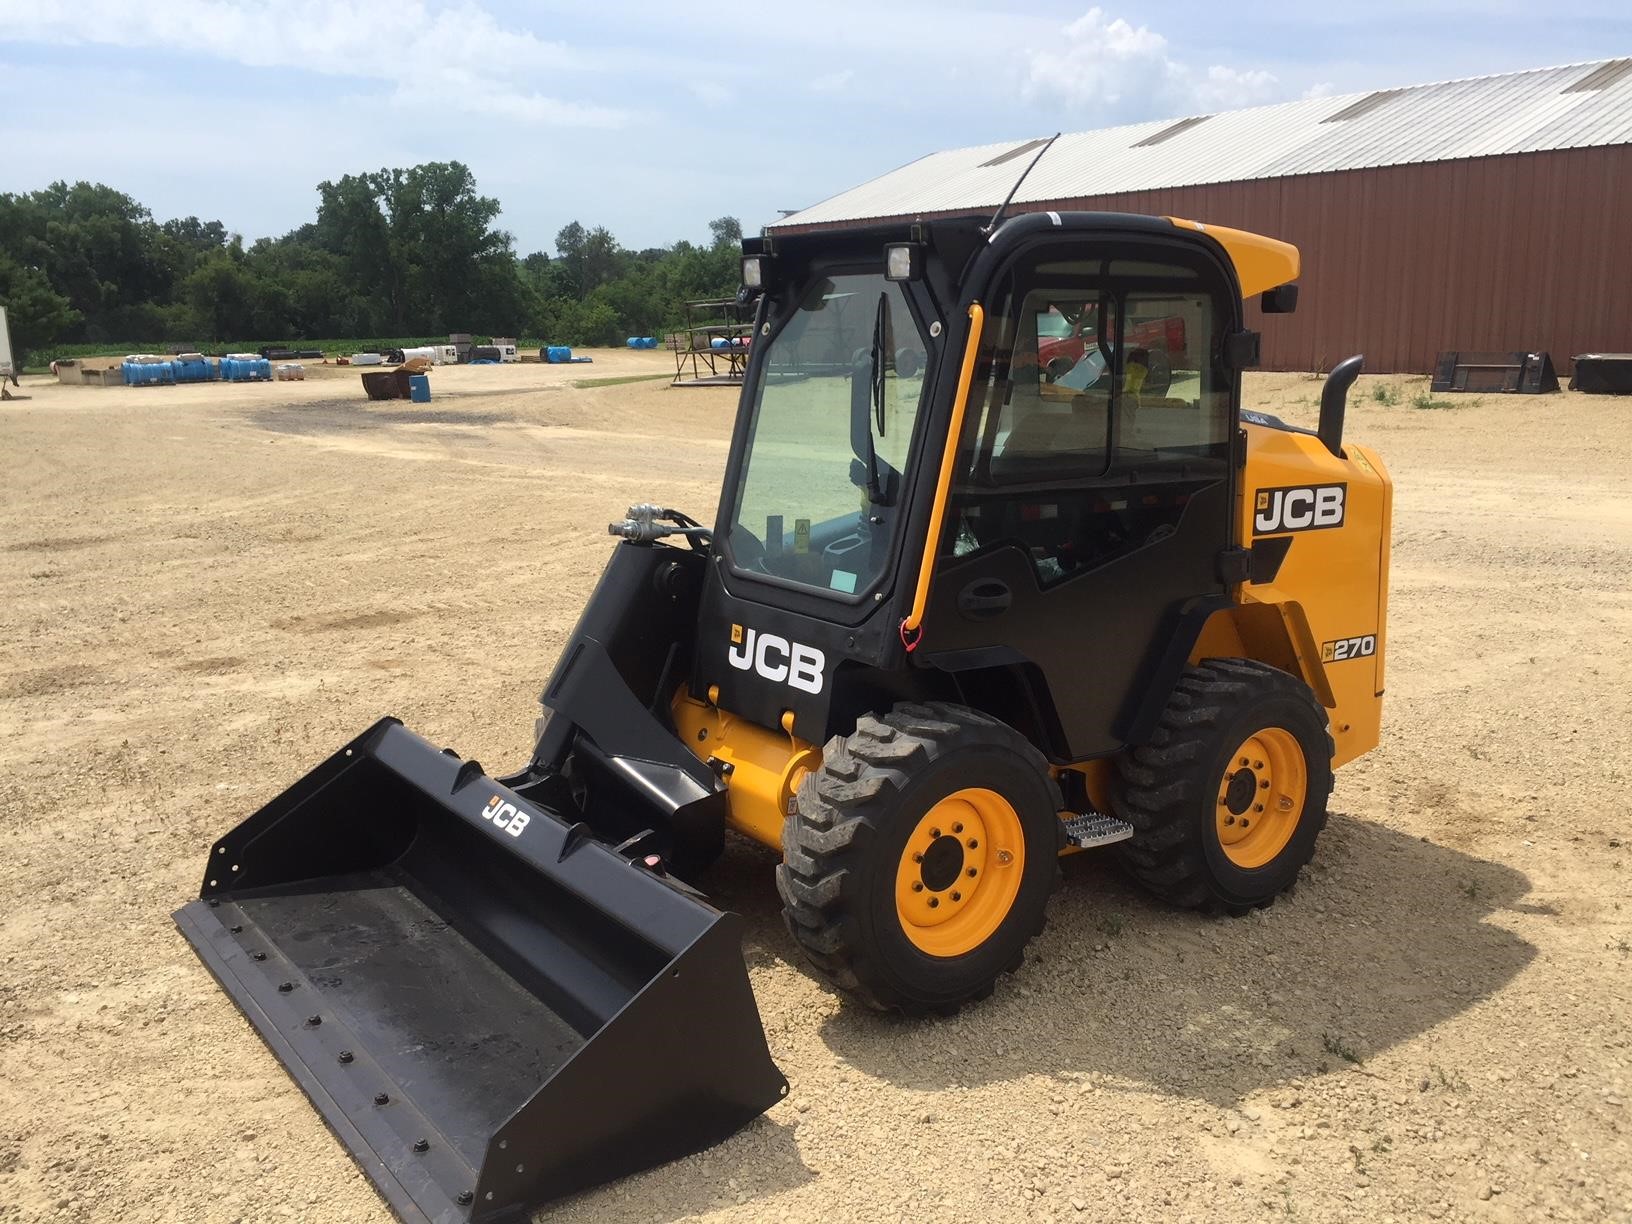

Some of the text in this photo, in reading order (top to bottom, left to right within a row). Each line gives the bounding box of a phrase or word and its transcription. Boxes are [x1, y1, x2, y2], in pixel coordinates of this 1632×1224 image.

[1255, 486, 1344, 532] JCB
[728, 628, 825, 695] JCB
[1334, 635, 1375, 660] 270
[482, 799, 531, 837] JCB
